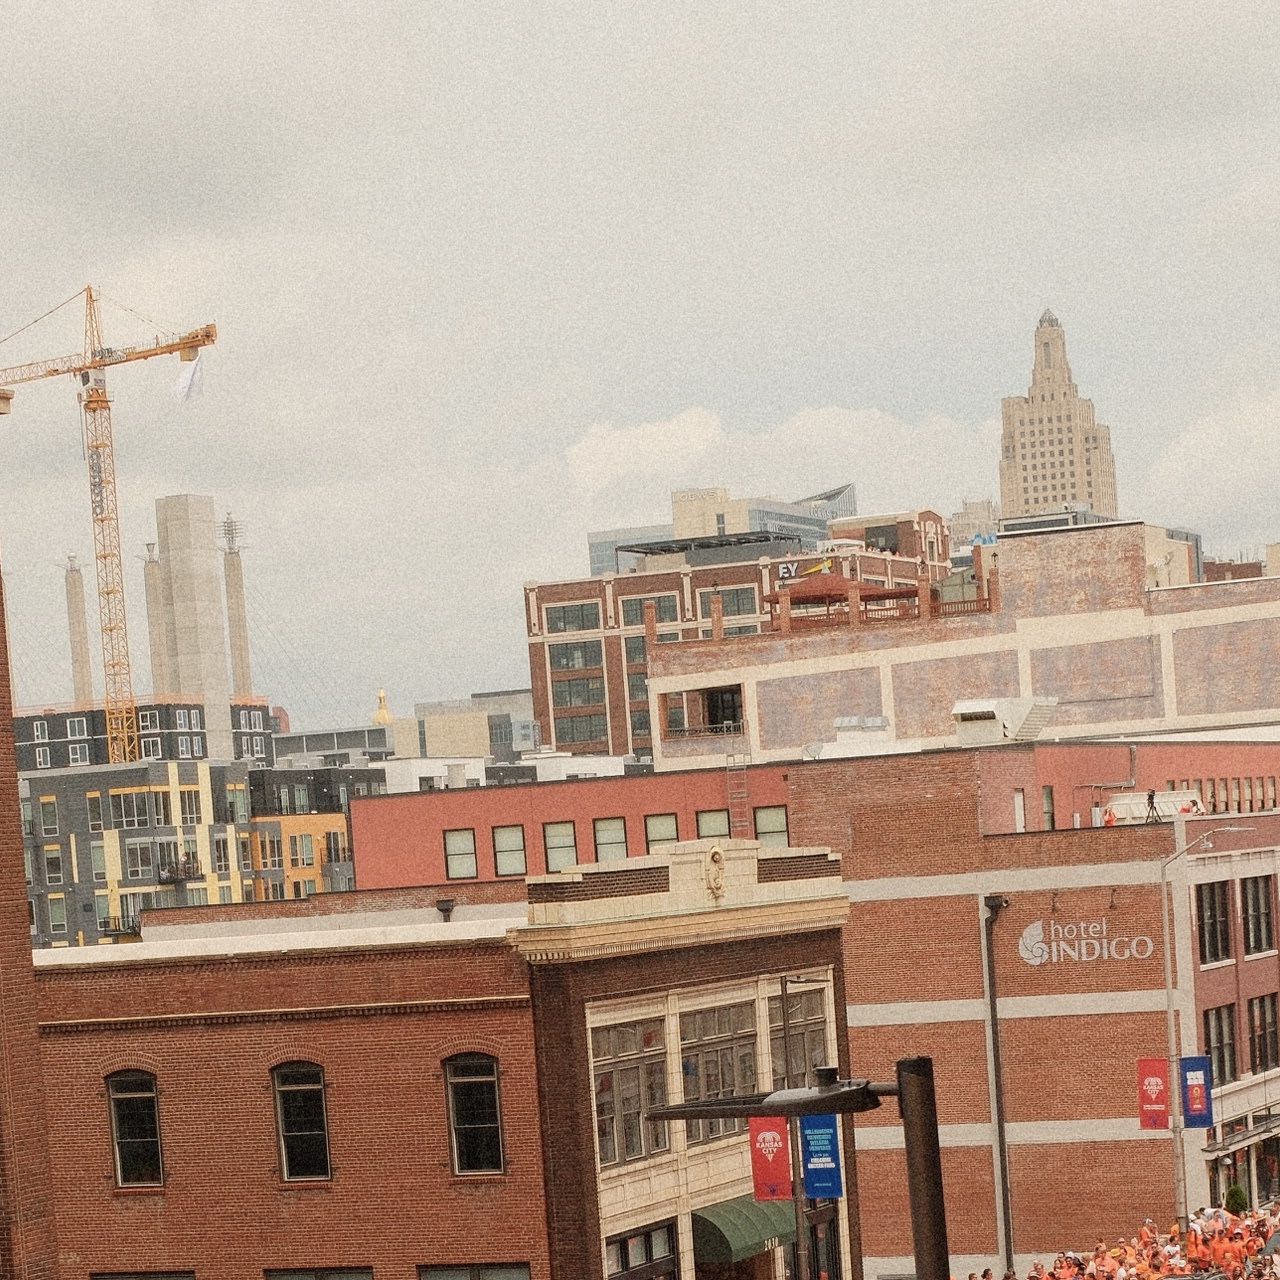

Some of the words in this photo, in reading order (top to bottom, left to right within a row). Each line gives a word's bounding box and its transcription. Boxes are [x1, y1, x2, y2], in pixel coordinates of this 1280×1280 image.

[779, 563, 797, 577] EY
[1051, 917, 1108, 938] hotel
[1051, 936, 1155, 962] INDIGO
[756, 1141, 783, 1149] KANSAS
[762, 1147, 779, 1155] CITY
